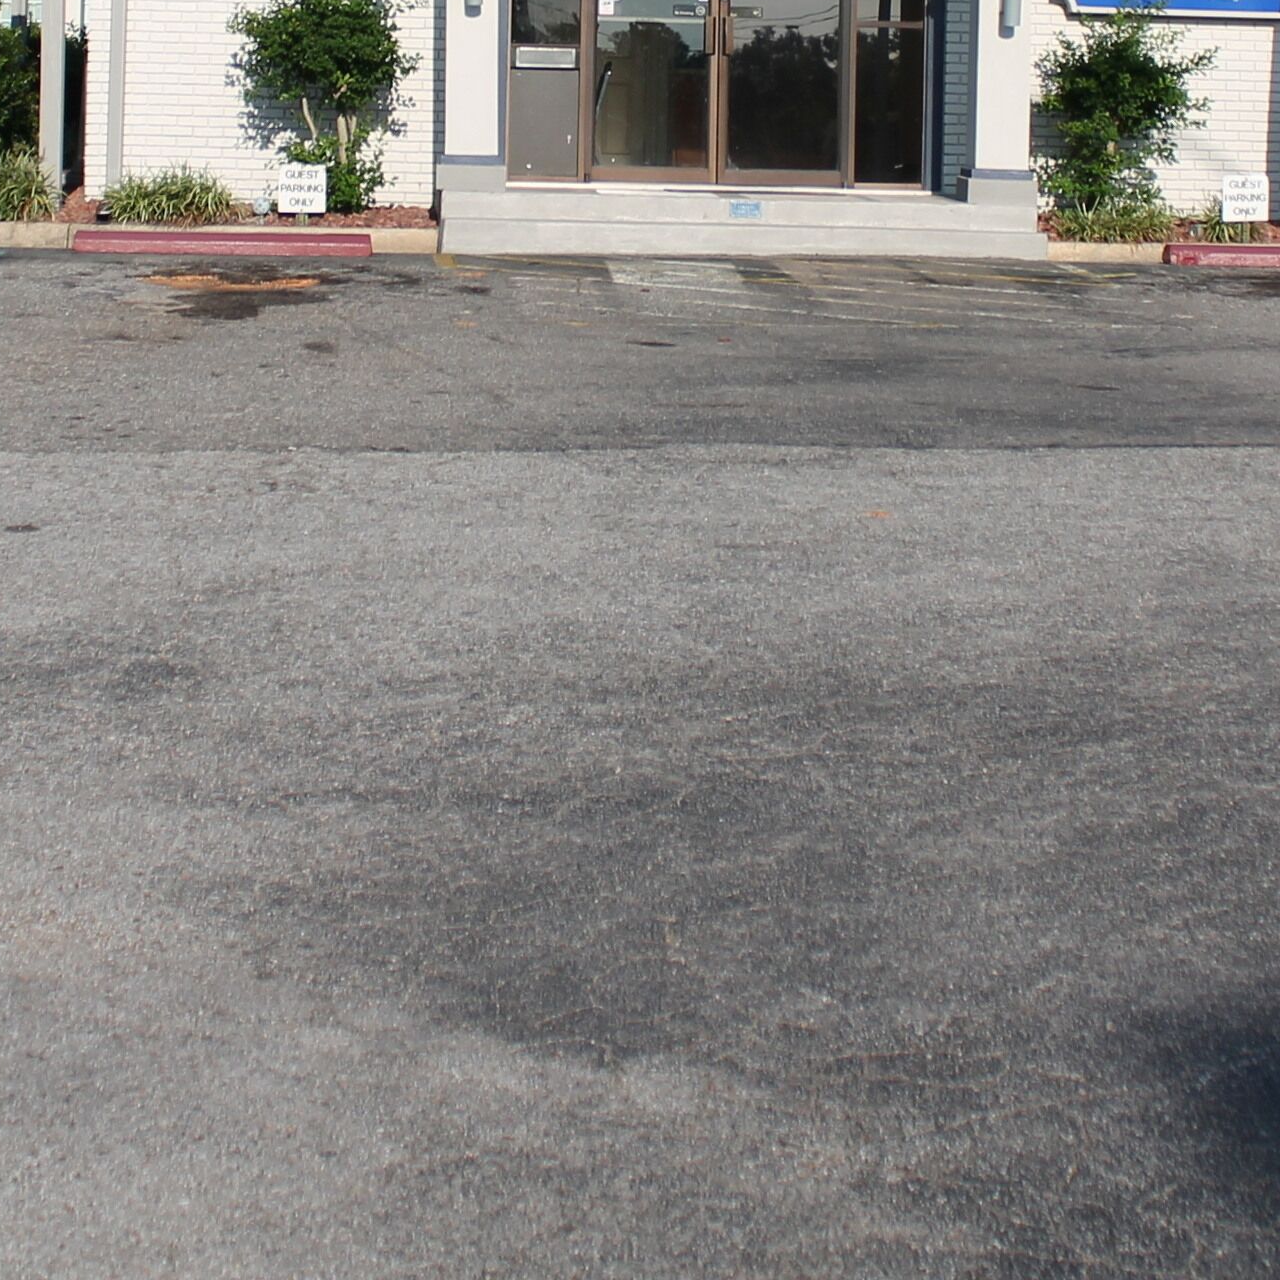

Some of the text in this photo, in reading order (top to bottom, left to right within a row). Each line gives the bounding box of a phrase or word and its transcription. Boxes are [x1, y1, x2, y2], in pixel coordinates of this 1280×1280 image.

[285, 170, 319, 179] GUEST
[280, 183, 324, 193] PARKING
[1229, 180, 1262, 189] GUEST
[289, 197, 314, 207] ONLY
[1224, 193, 1266, 202] PARKING
[1233, 207, 1258, 216] ONLY
